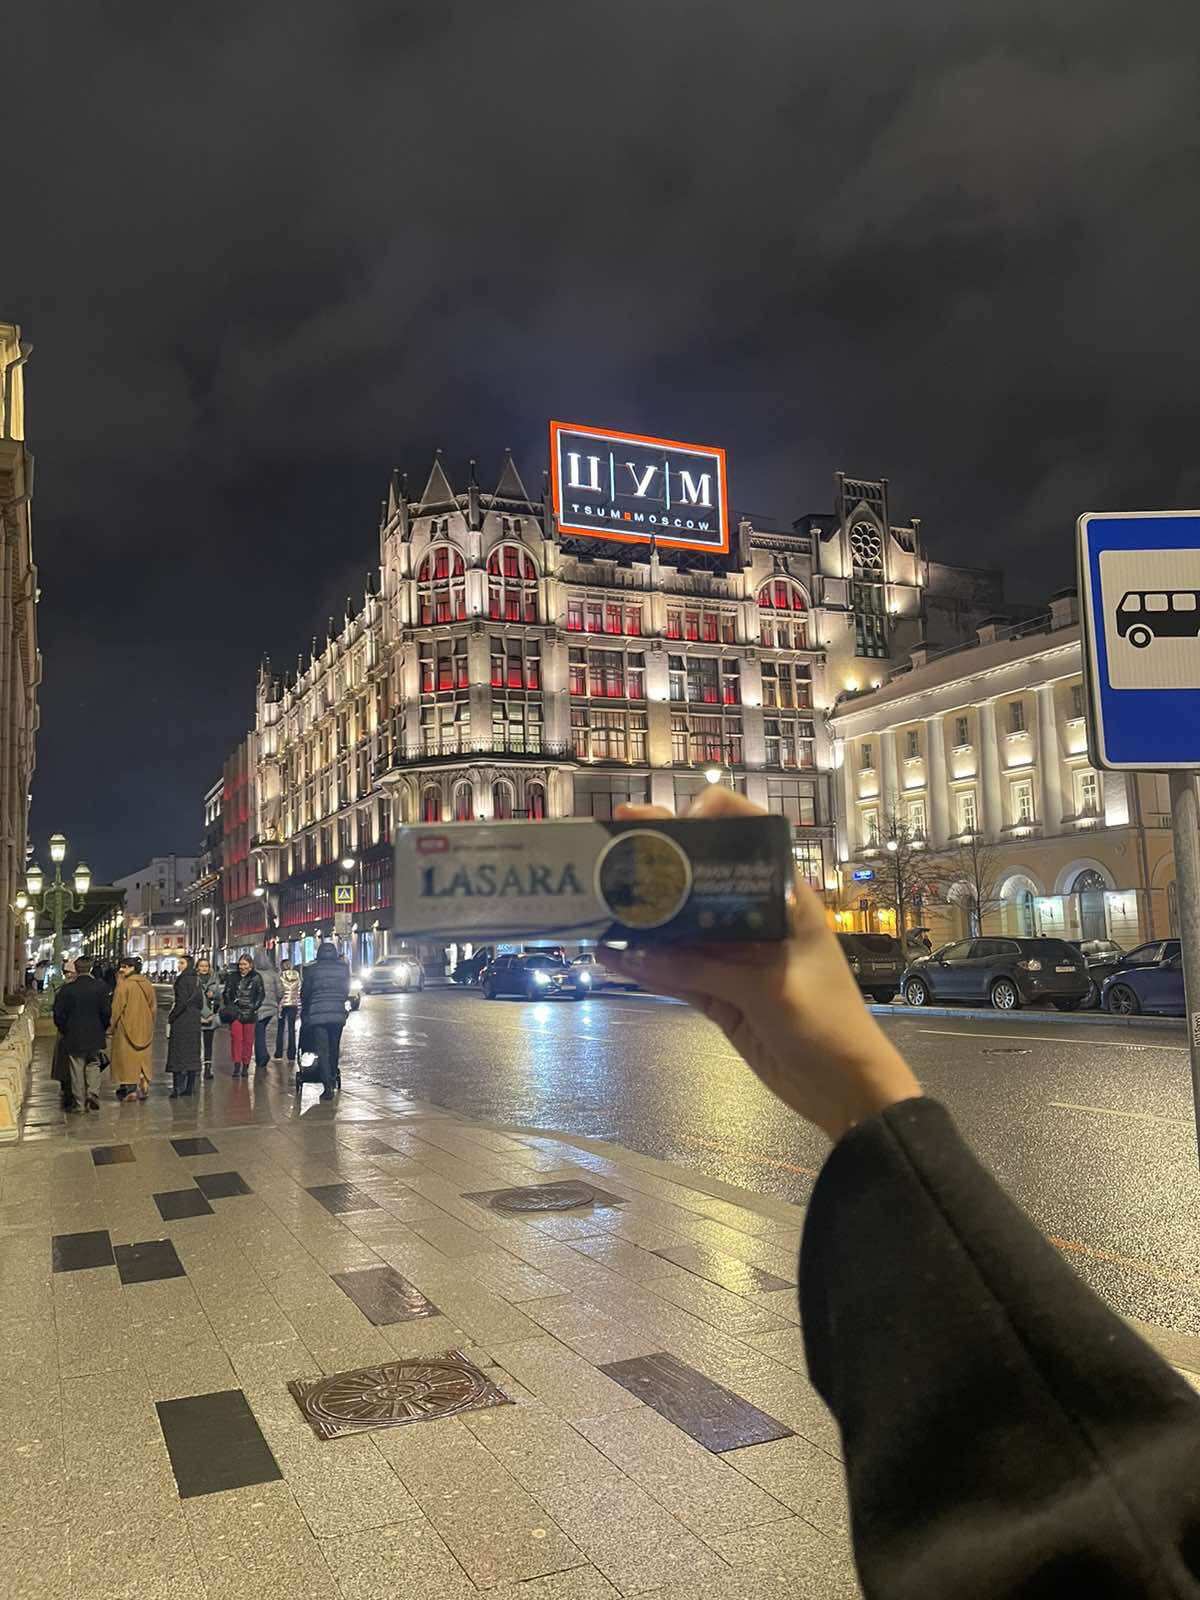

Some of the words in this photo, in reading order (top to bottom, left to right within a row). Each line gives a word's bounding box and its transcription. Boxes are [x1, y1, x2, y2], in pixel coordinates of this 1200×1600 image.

[571, 503, 621, 520] TSUM
[634, 512, 710, 531] MOSCOW
[418, 862, 587, 897] LASARA
